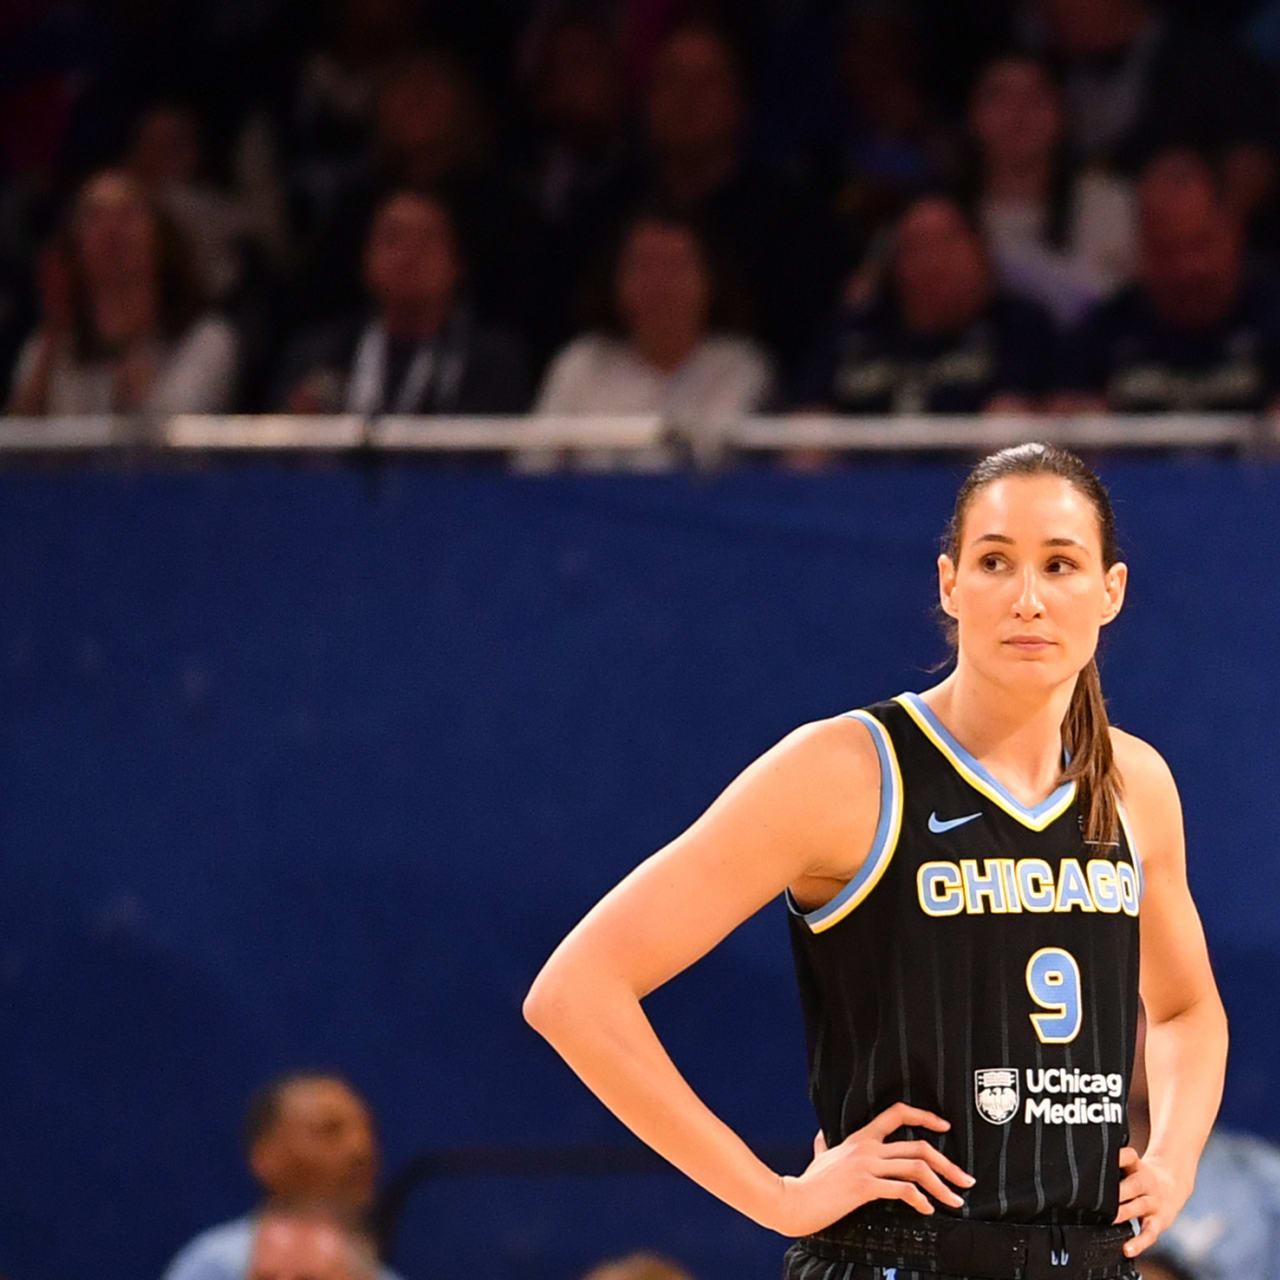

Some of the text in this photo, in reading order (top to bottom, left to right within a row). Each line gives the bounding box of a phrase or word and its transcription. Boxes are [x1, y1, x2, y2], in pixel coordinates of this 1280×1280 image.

[917, 858, 1139, 917] CHICAGO
[1025, 947, 1082, 1043] 9
[1026, 1068, 1122, 1097] UChicag
[1025, 1097, 1122, 1124] Medicin
